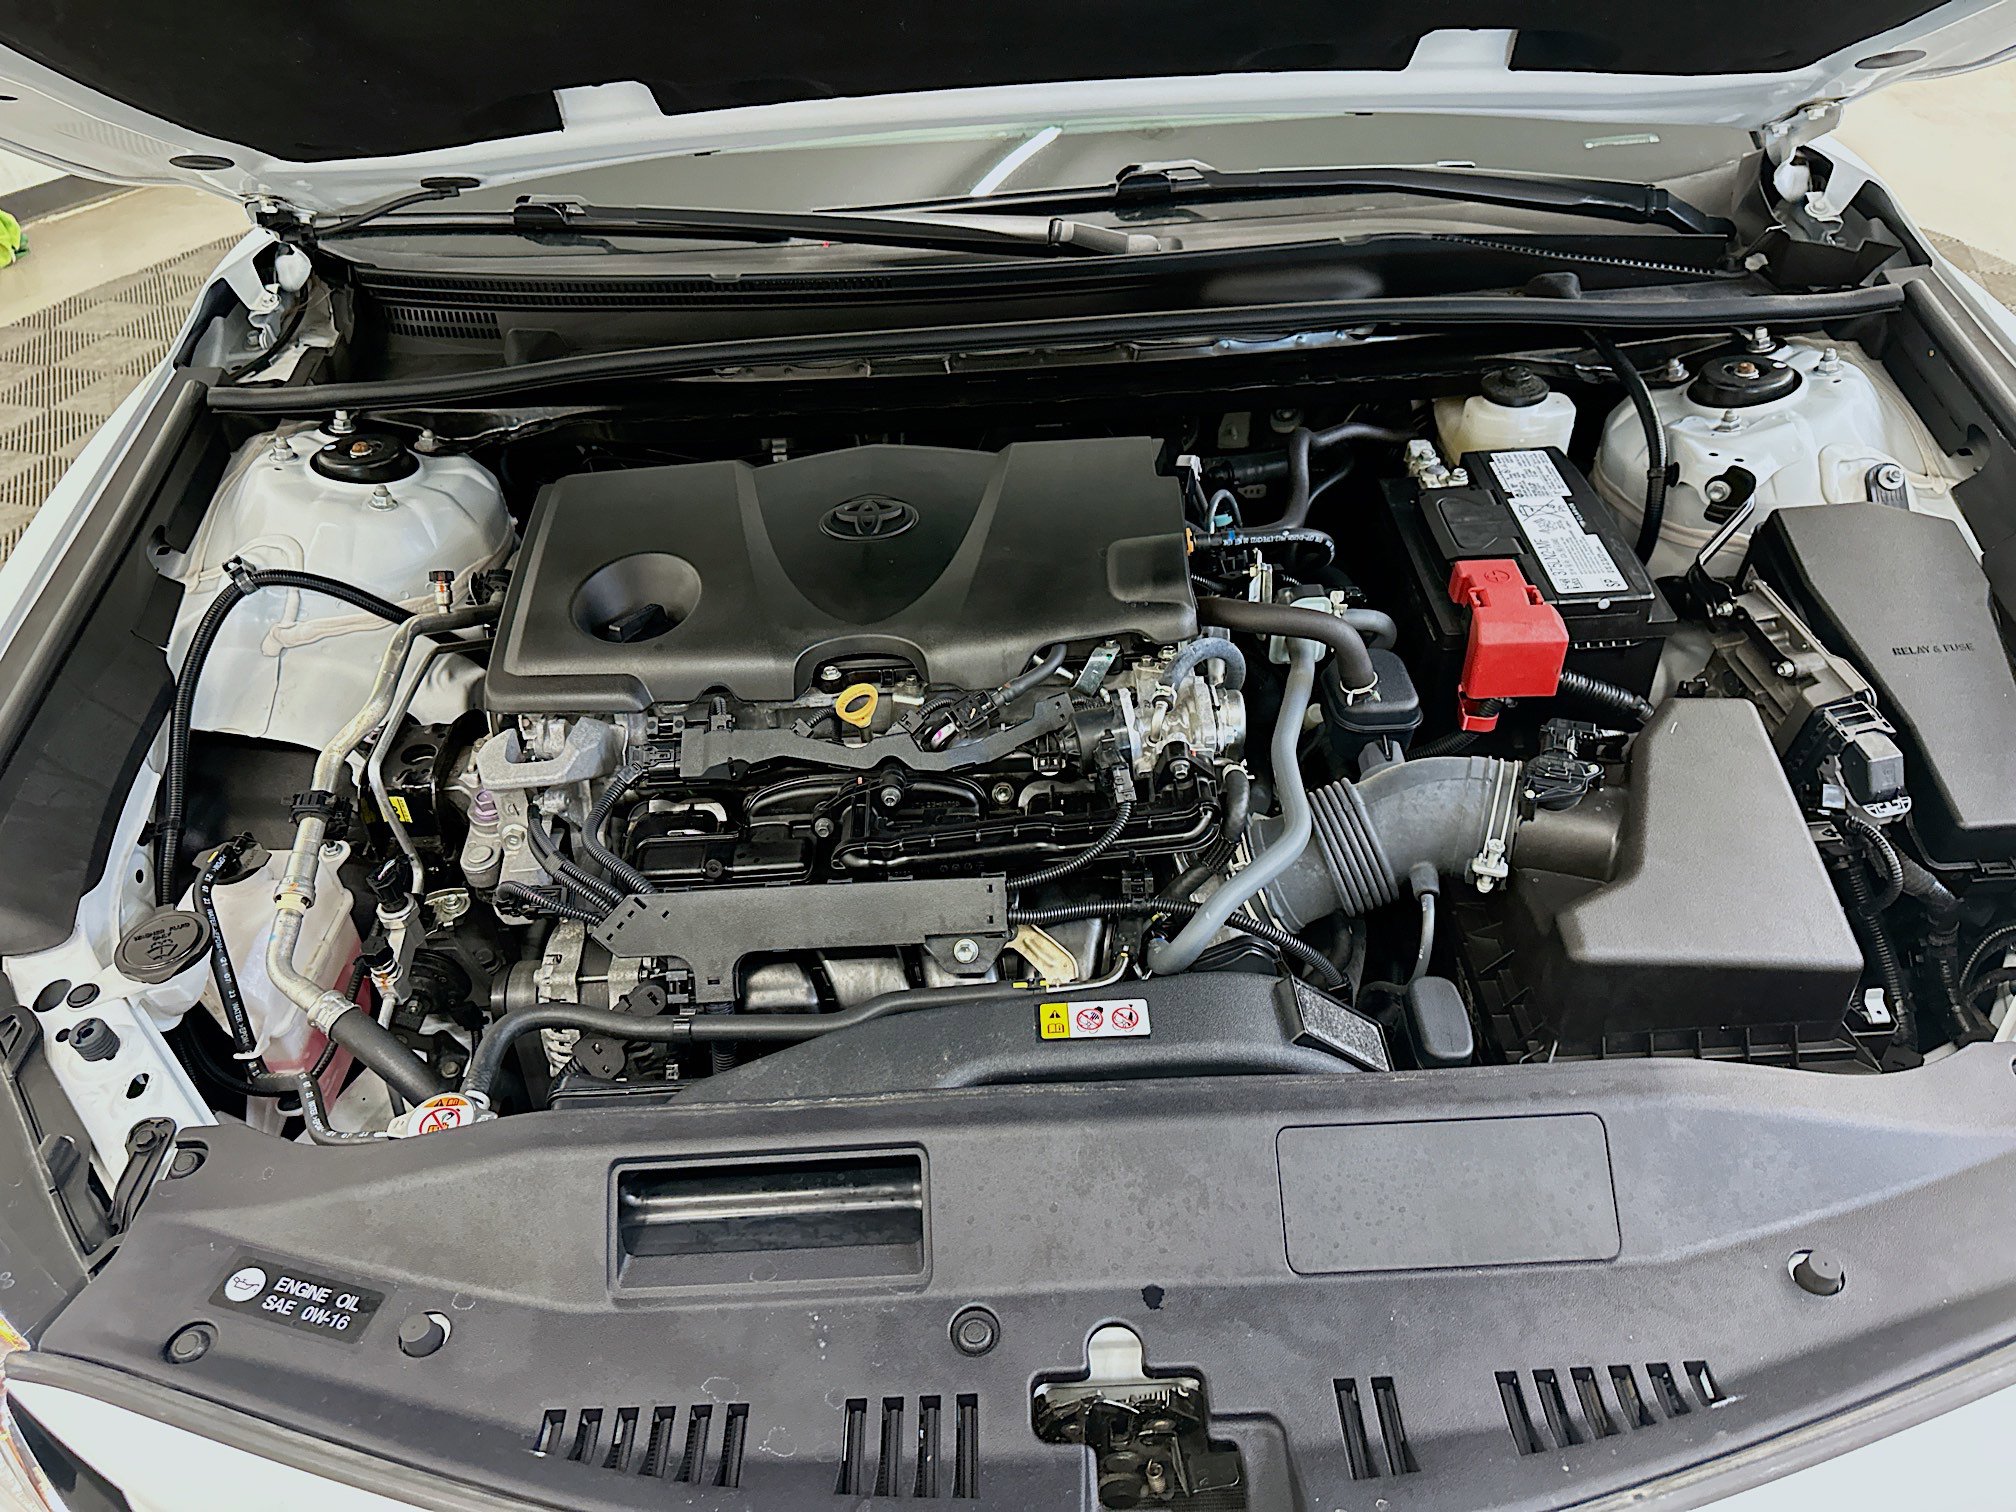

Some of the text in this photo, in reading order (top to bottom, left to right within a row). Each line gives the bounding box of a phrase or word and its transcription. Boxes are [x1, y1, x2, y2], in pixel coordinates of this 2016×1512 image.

[1891, 642, 1975, 656] RELAY & FUSE
[232, 1001, 243, 1024] WATER
[273, 1276, 361, 1312] ENGINE OIL
[261, 1295, 351, 1331] SAE 0W-16
